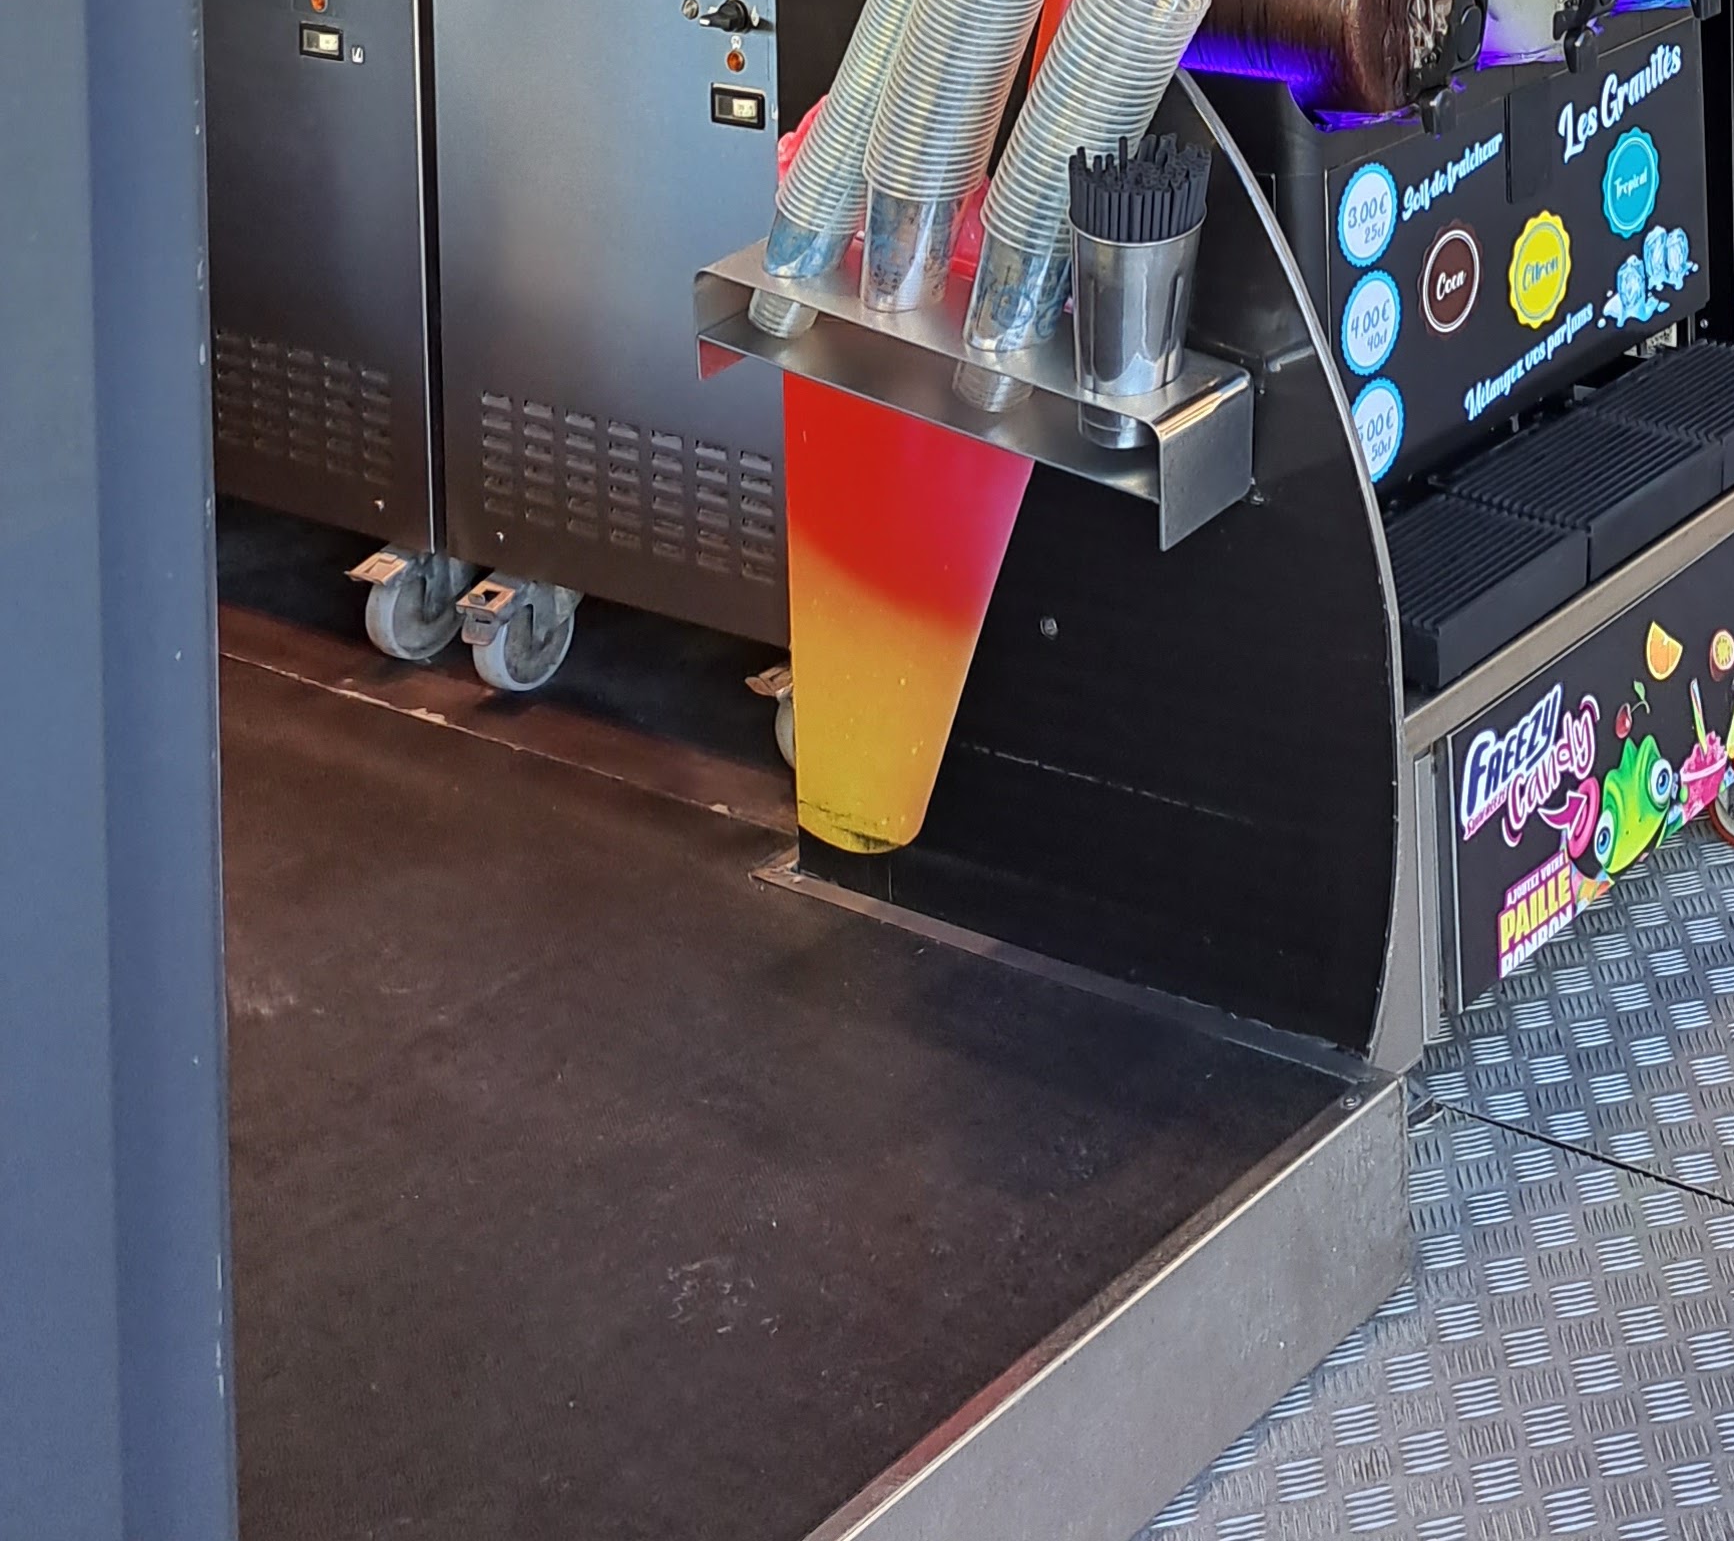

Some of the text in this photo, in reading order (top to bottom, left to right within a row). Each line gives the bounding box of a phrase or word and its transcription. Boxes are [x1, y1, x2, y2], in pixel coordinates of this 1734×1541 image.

[1557, 101, 1599, 165] Les
[1613, 166, 1649, 201] Tropical
[1520, 253, 1561, 293] Citron
[1524, 302, 1594, 371] vos parfums
[1508, 710, 1596, 831] Candy
[1500, 863, 1573, 954] PAILLE
